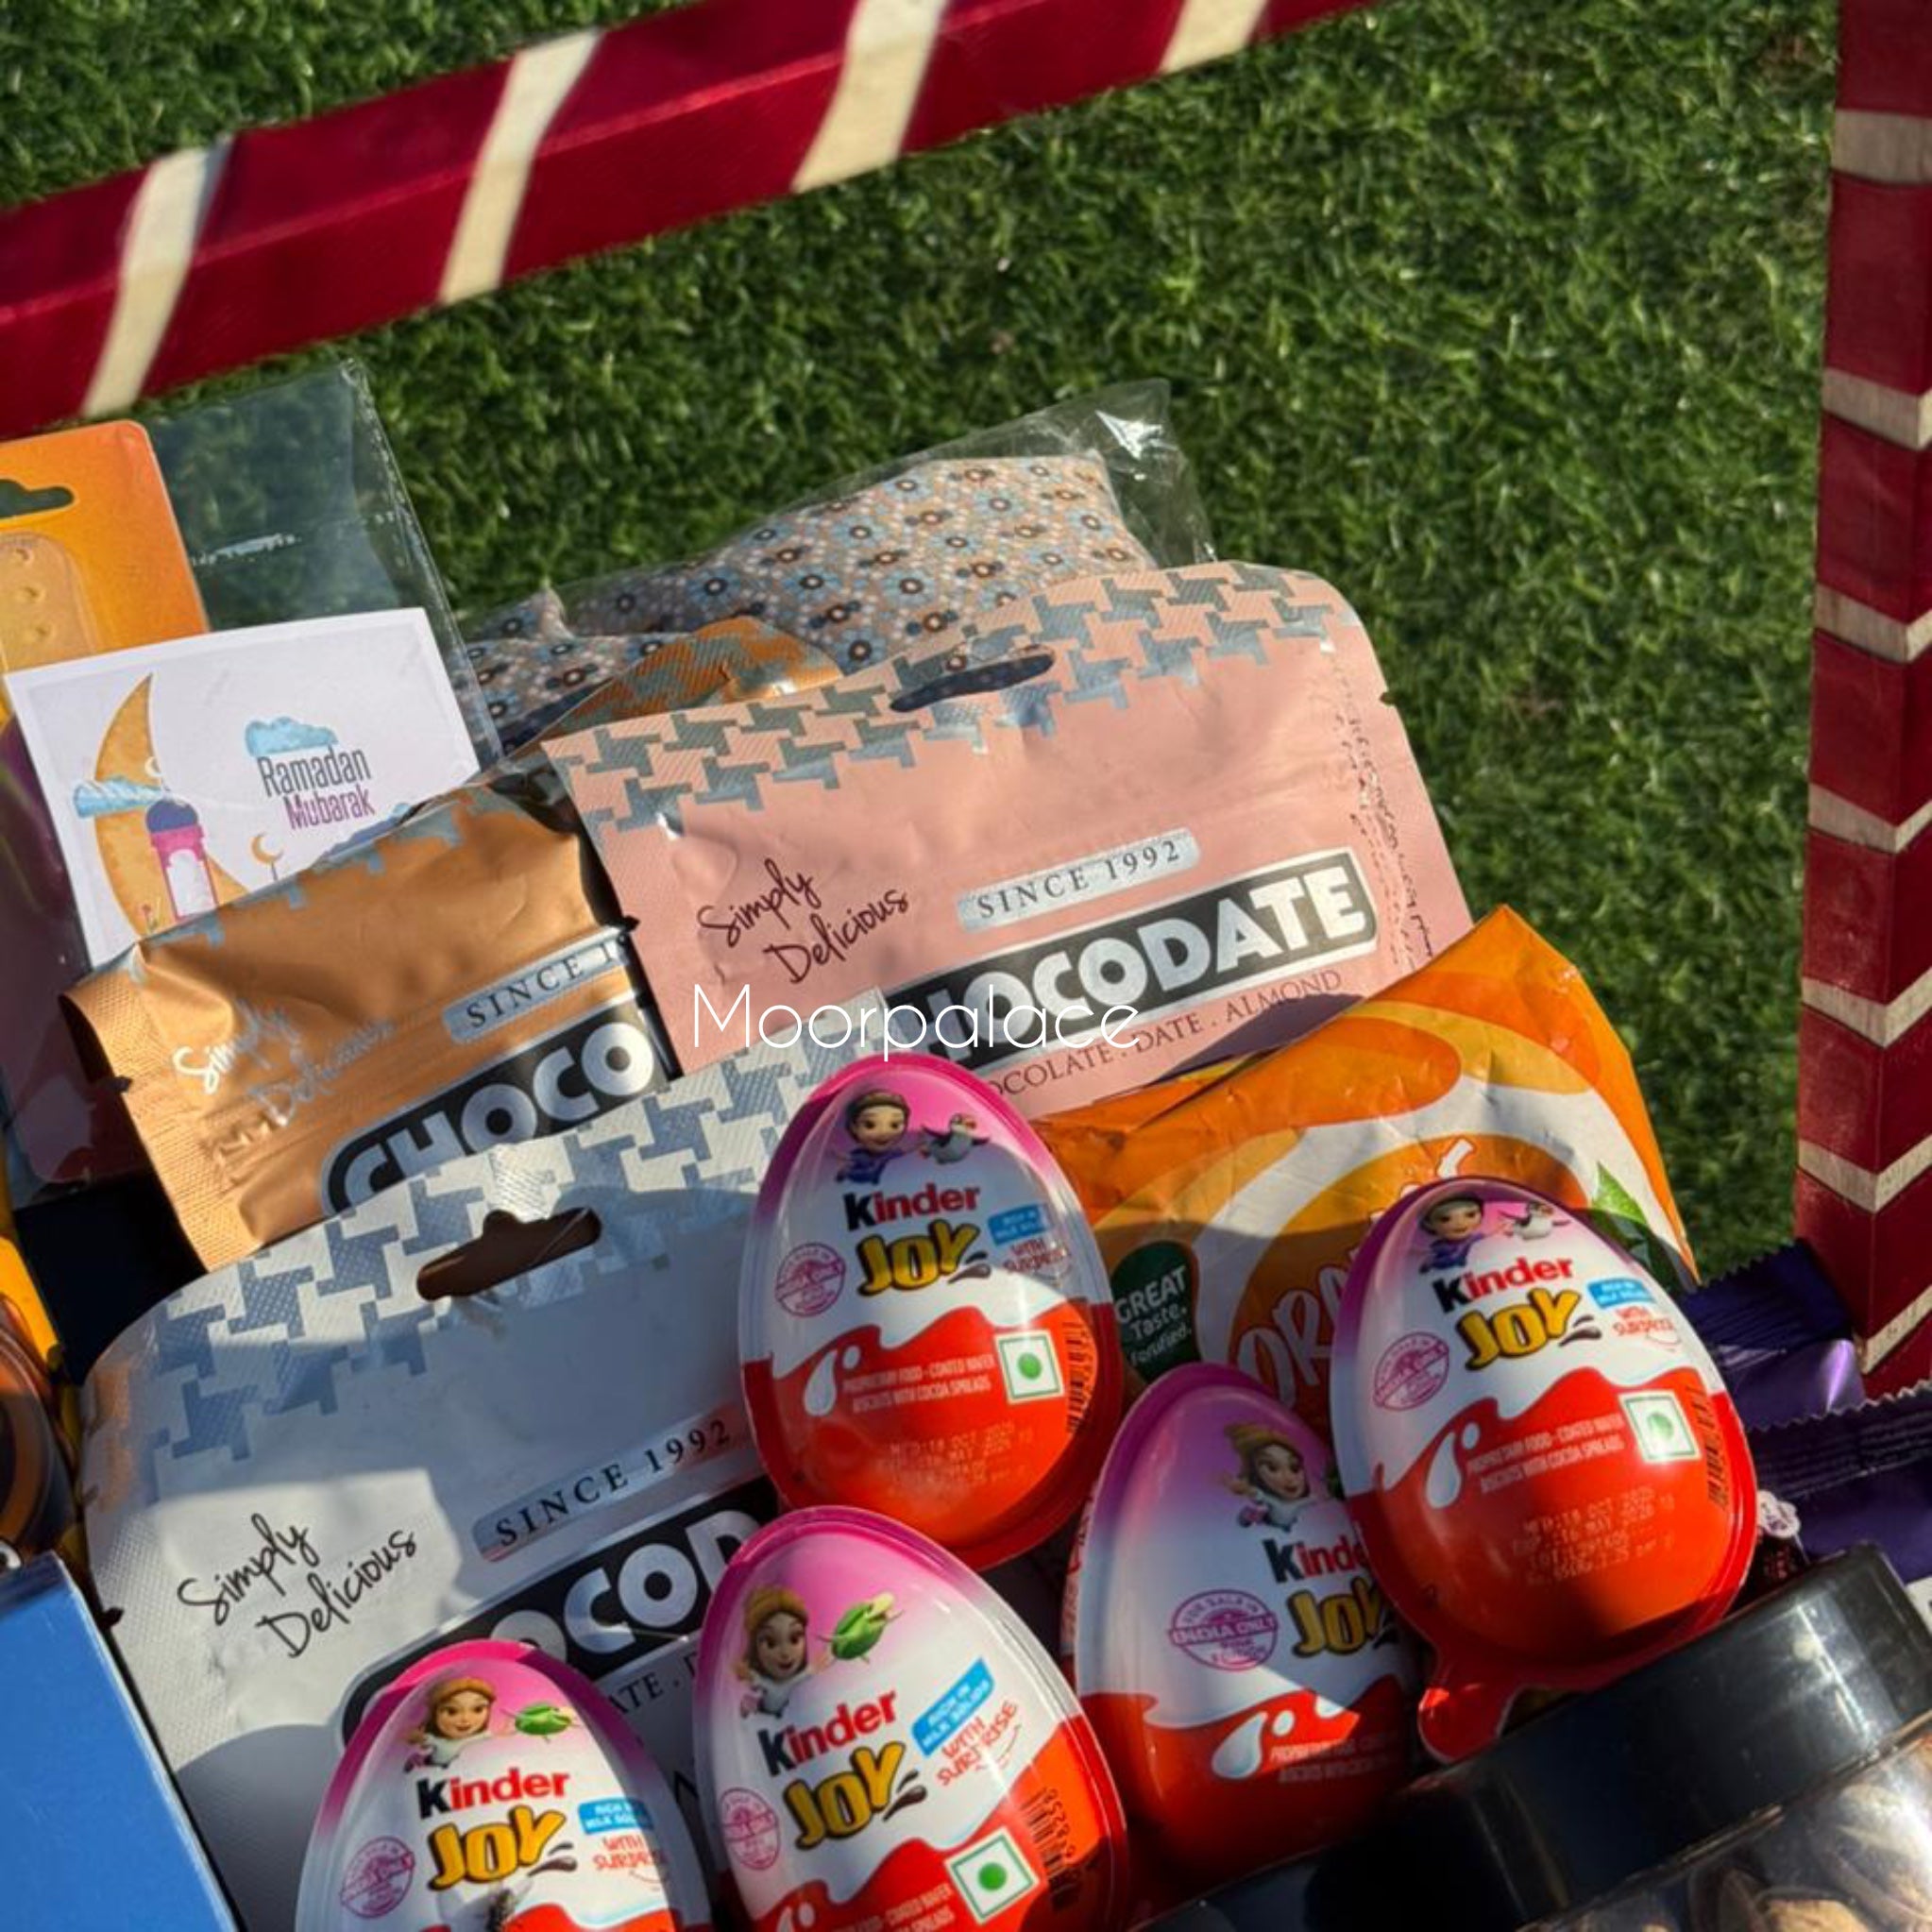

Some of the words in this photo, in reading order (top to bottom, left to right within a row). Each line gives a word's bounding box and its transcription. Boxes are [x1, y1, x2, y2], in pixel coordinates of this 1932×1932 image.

[257, 744, 371, 797] Ramadan
[283, 783, 376, 829] Mubarak
[698, 858, 822, 946] Simply
[976, 869, 1091, 919] SINCE
[1103, 839, 1182, 882] 1992
[763, 885, 909, 984] Delicious
[466, 955, 585, 1029] SINCE
[1131, 1012, 1202, 1054] DATE
[1226, 968, 1342, 1026] ALMOND
[843, 1183, 981, 1233] Kinder
[855, 1218, 982, 1297] JOY
[1113, 1265, 1187, 1324] GREAT
[1432, 1256, 1575, 1313] Kinder
[1129, 1299, 1188, 1341] Taste.
[1456, 1287, 1583, 1371] JOY
[496, 1464, 629, 1547] SINCE
[644, 1419, 731, 1474] 1992
[177, 1512, 316, 1626] Simply
[256, 1528, 418, 1658] Delicious
[758, 1691, 897, 1777] Kinder
[415, 1768, 571, 1821] Kinder
[782, 1739, 906, 1851] JOY
[426, 1804, 568, 1890] JOY
